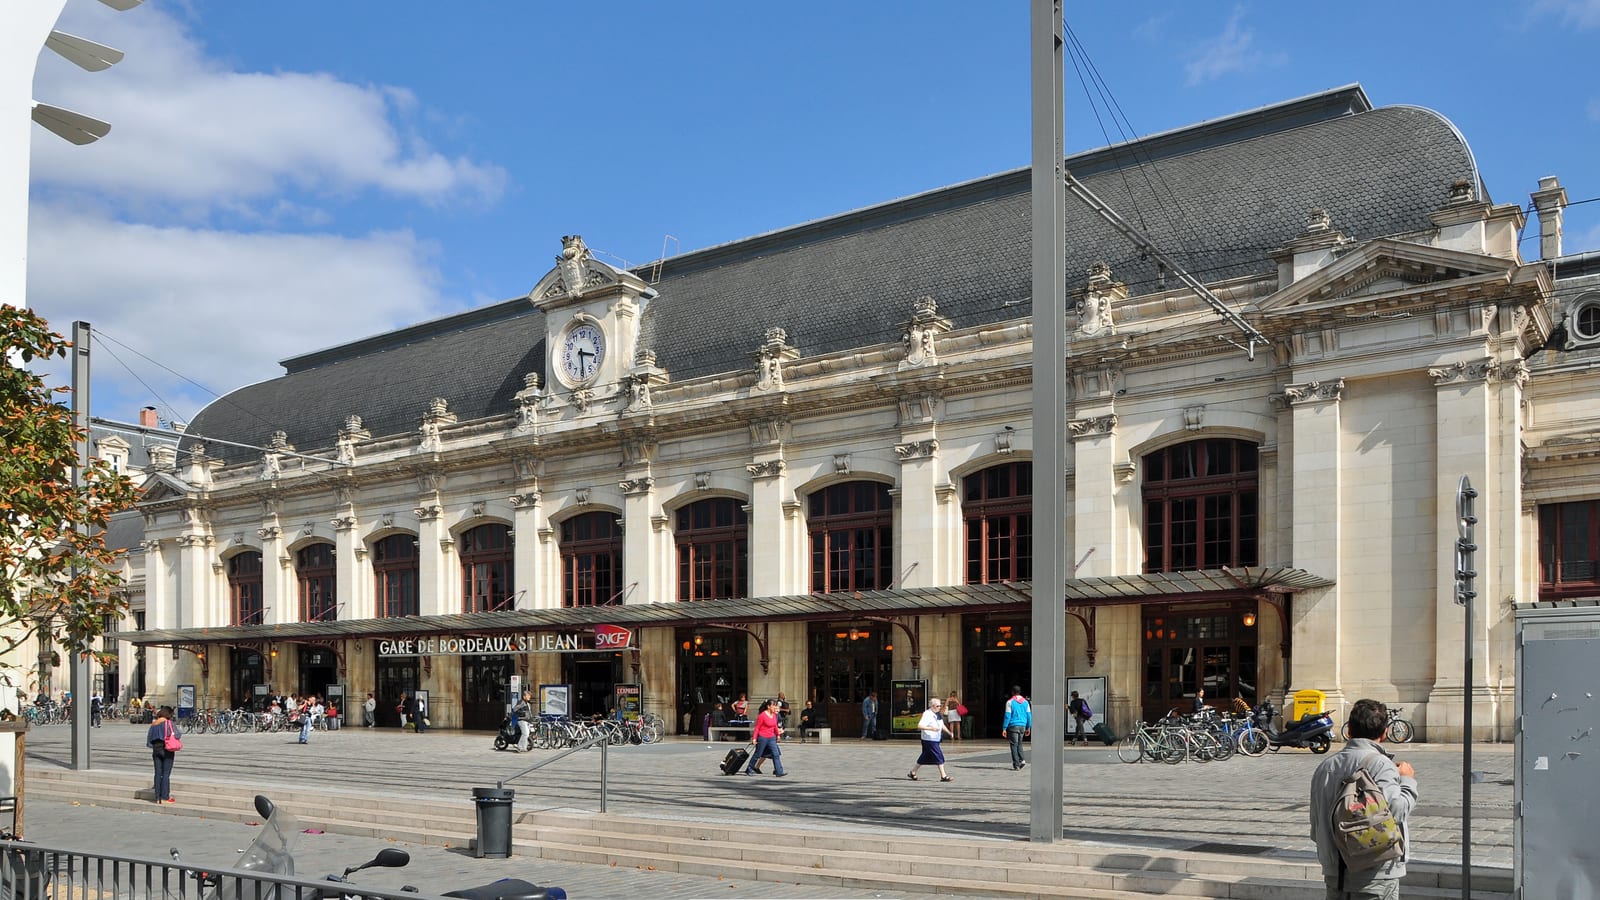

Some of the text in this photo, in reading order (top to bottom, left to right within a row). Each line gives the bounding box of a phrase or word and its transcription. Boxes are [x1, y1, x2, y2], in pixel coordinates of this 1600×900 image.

[572, 334, 578, 342] 11
[579, 330, 586, 338] 12
[588, 331, 592, 339] 1
[593, 336, 598, 345] 2
[567, 342, 574, 350] 10
[595, 346, 600, 354] 3
[566, 353, 571, 361] 9
[592, 356, 597, 364] 4
[568, 362, 572, 370] 8
[588, 365, 593, 373] 5
[573, 367, 578, 376] 7
[596, 632, 627, 645] SNCF
[380, 634, 578, 655] GARE DE BORDEAUX ST JEAN
